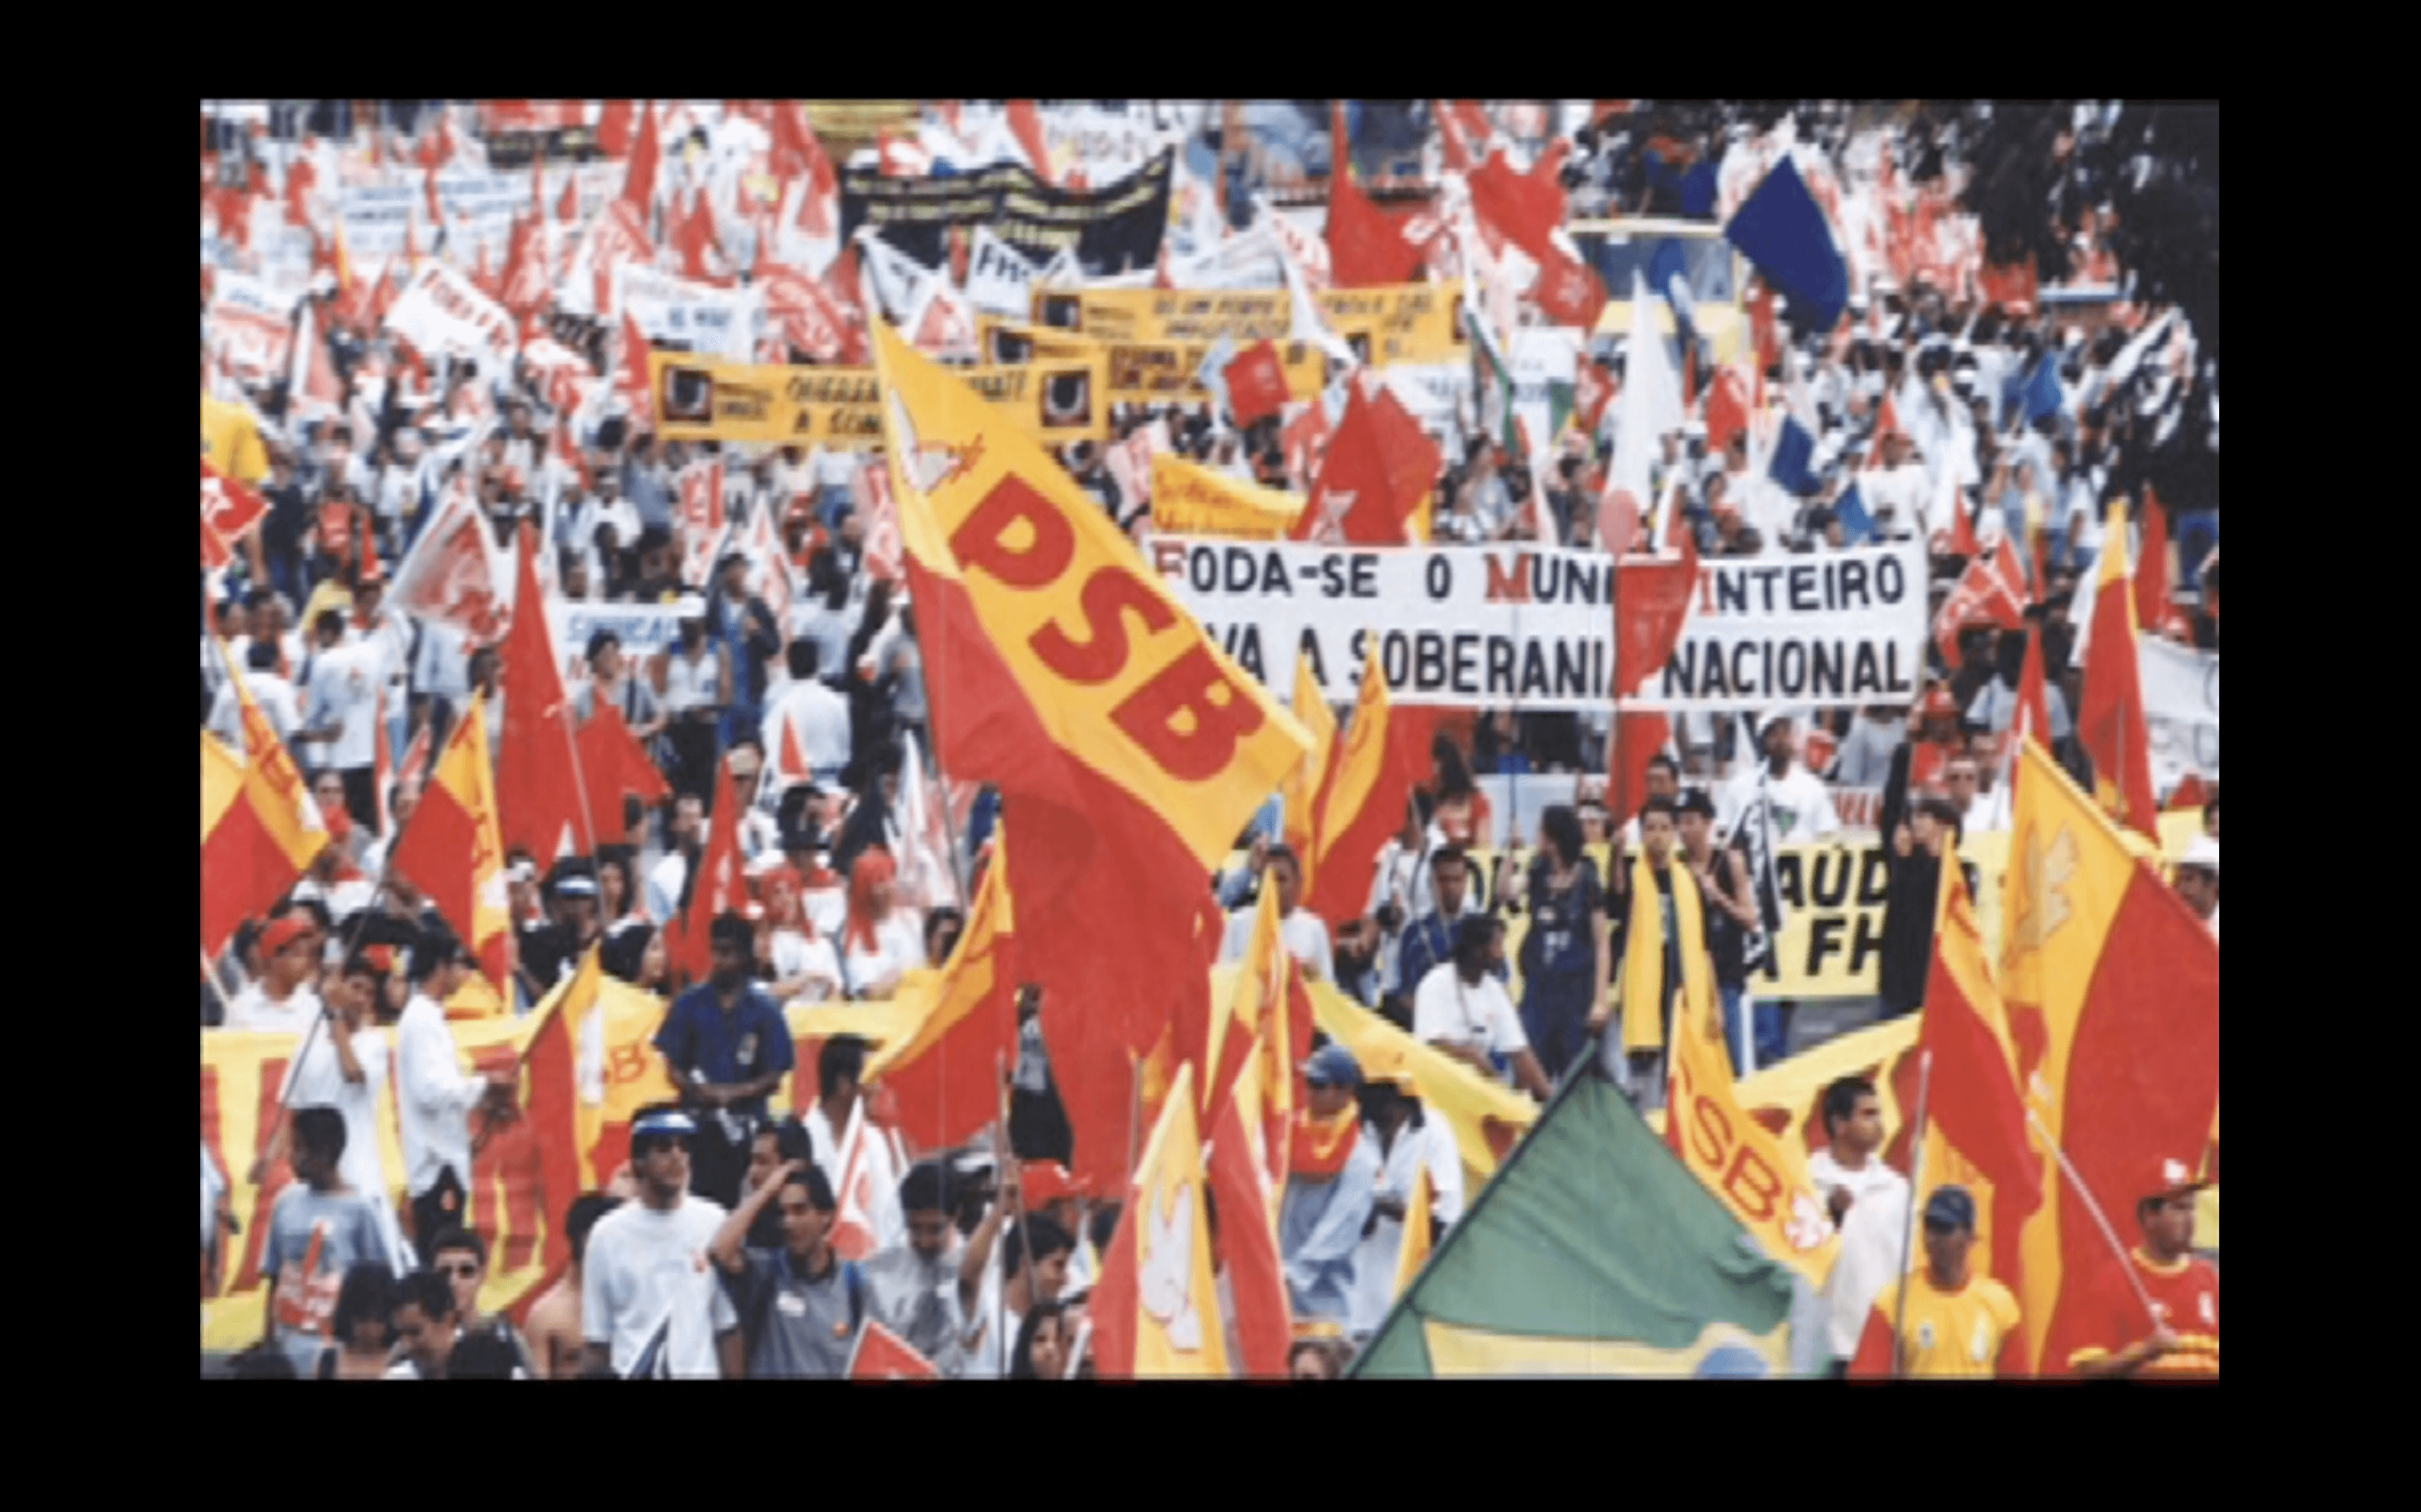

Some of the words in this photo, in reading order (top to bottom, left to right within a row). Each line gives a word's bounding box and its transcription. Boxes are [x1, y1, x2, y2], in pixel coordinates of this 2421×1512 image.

[1150, 540, 1380, 600] FODA-SE
[1426, 551, 1453, 600] O
[1484, 552, 1613, 605] MUN
[1698, 555, 1906, 616] INTEIRO
[950, 471, 1266, 783] PSB
[1204, 621, 1268, 682] VA
[1348, 627, 1616, 700] SOBERANI
[1662, 638, 1912, 699] NACIONAL
[1777, 843, 1889, 909] AÚD
[1680, 1055, 1783, 1222] SB
